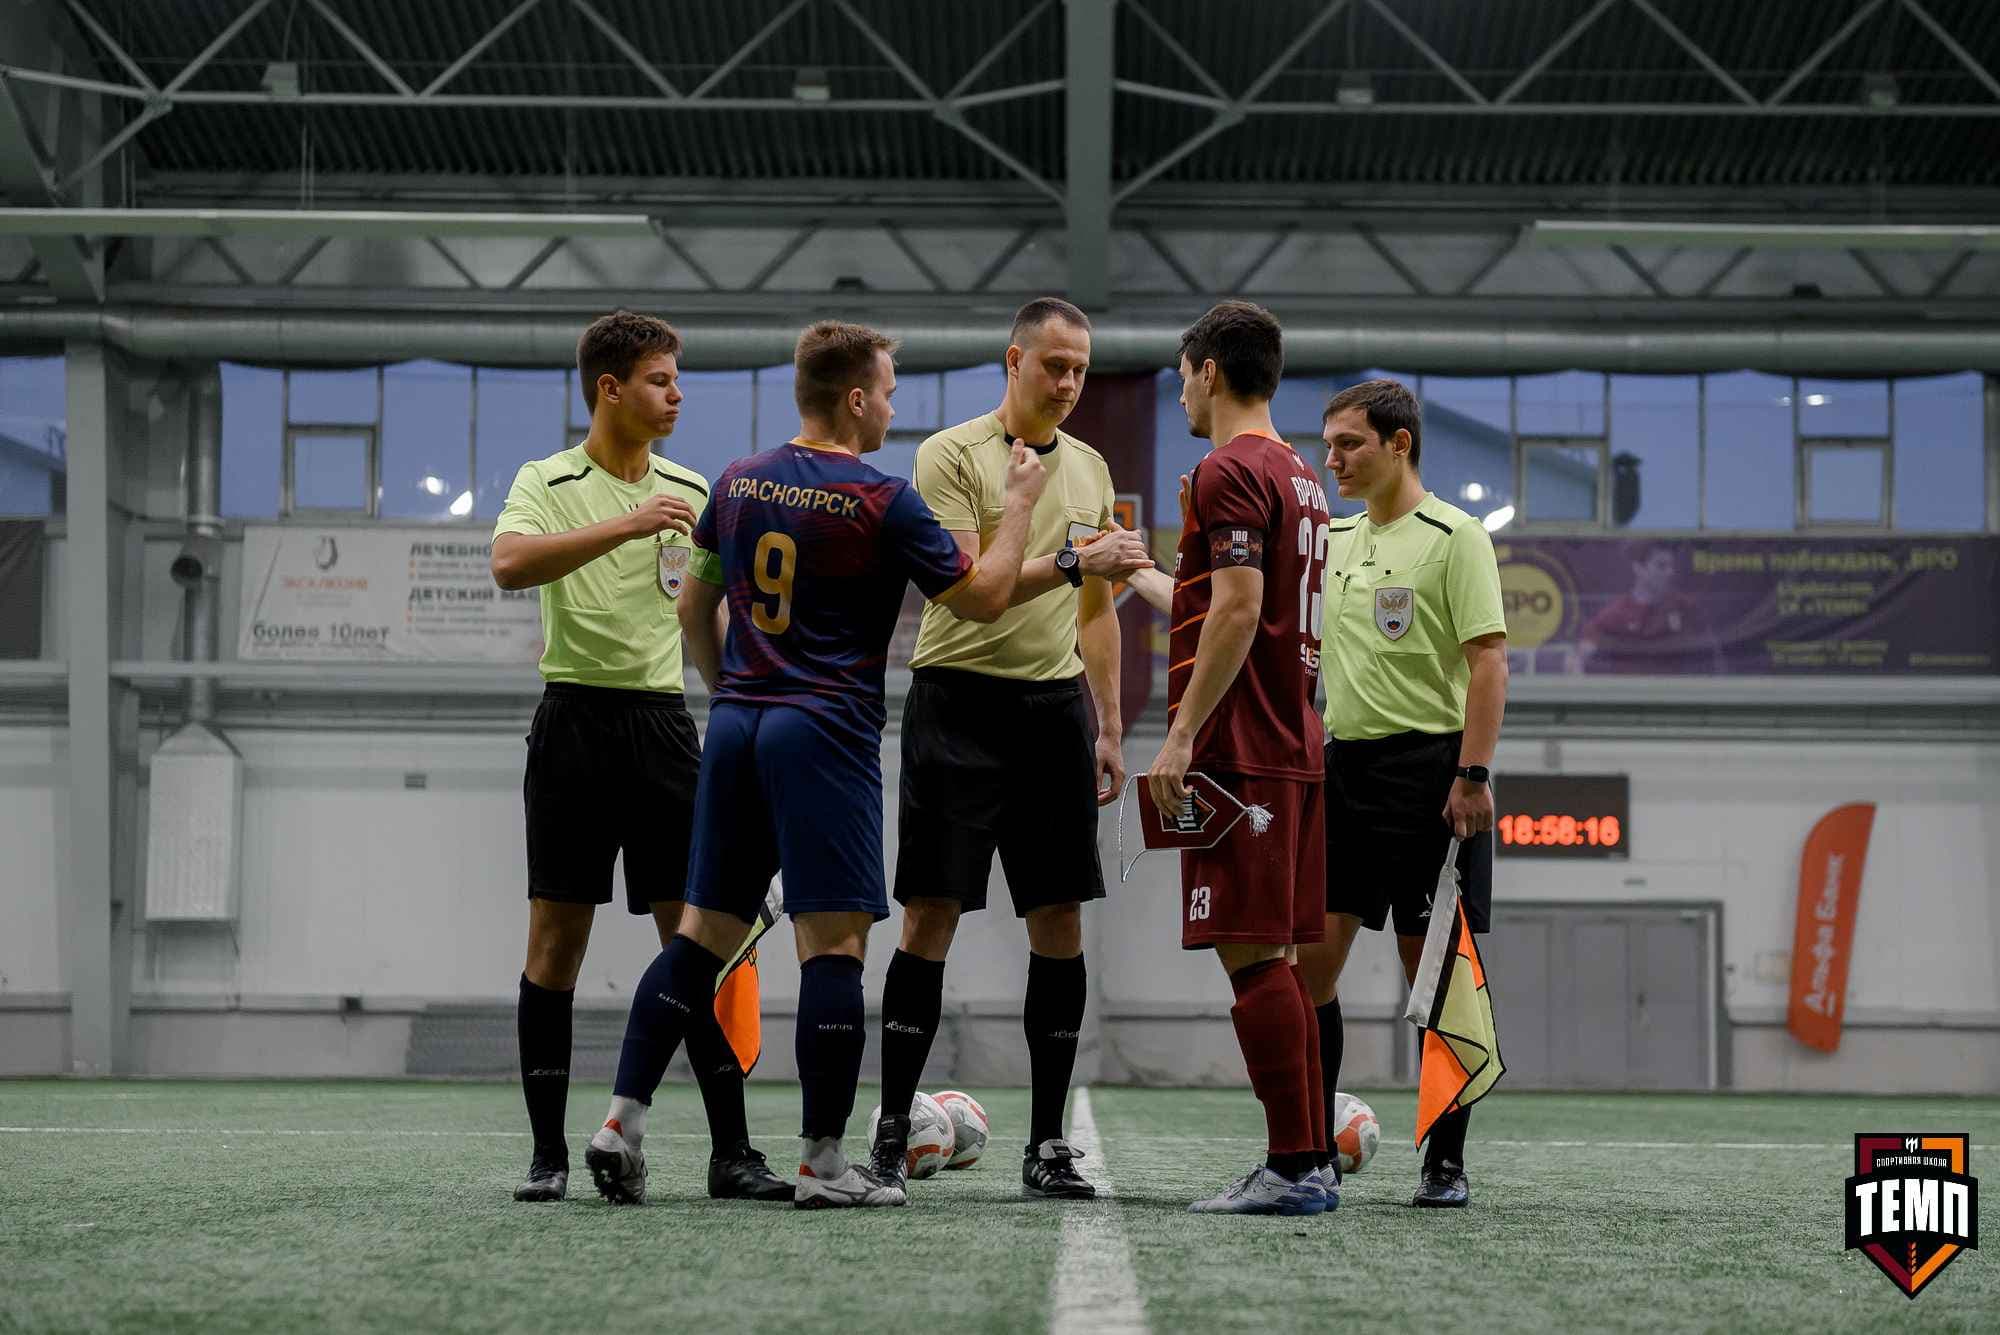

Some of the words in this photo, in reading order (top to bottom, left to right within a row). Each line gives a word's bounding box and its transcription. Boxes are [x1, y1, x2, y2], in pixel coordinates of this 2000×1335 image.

[727, 477, 861, 518] КРАСНОЯРСК
[1231, 530, 1248, 542] 100
[751, 531, 797, 635] 9
[1189, 886, 1212, 921] 23
